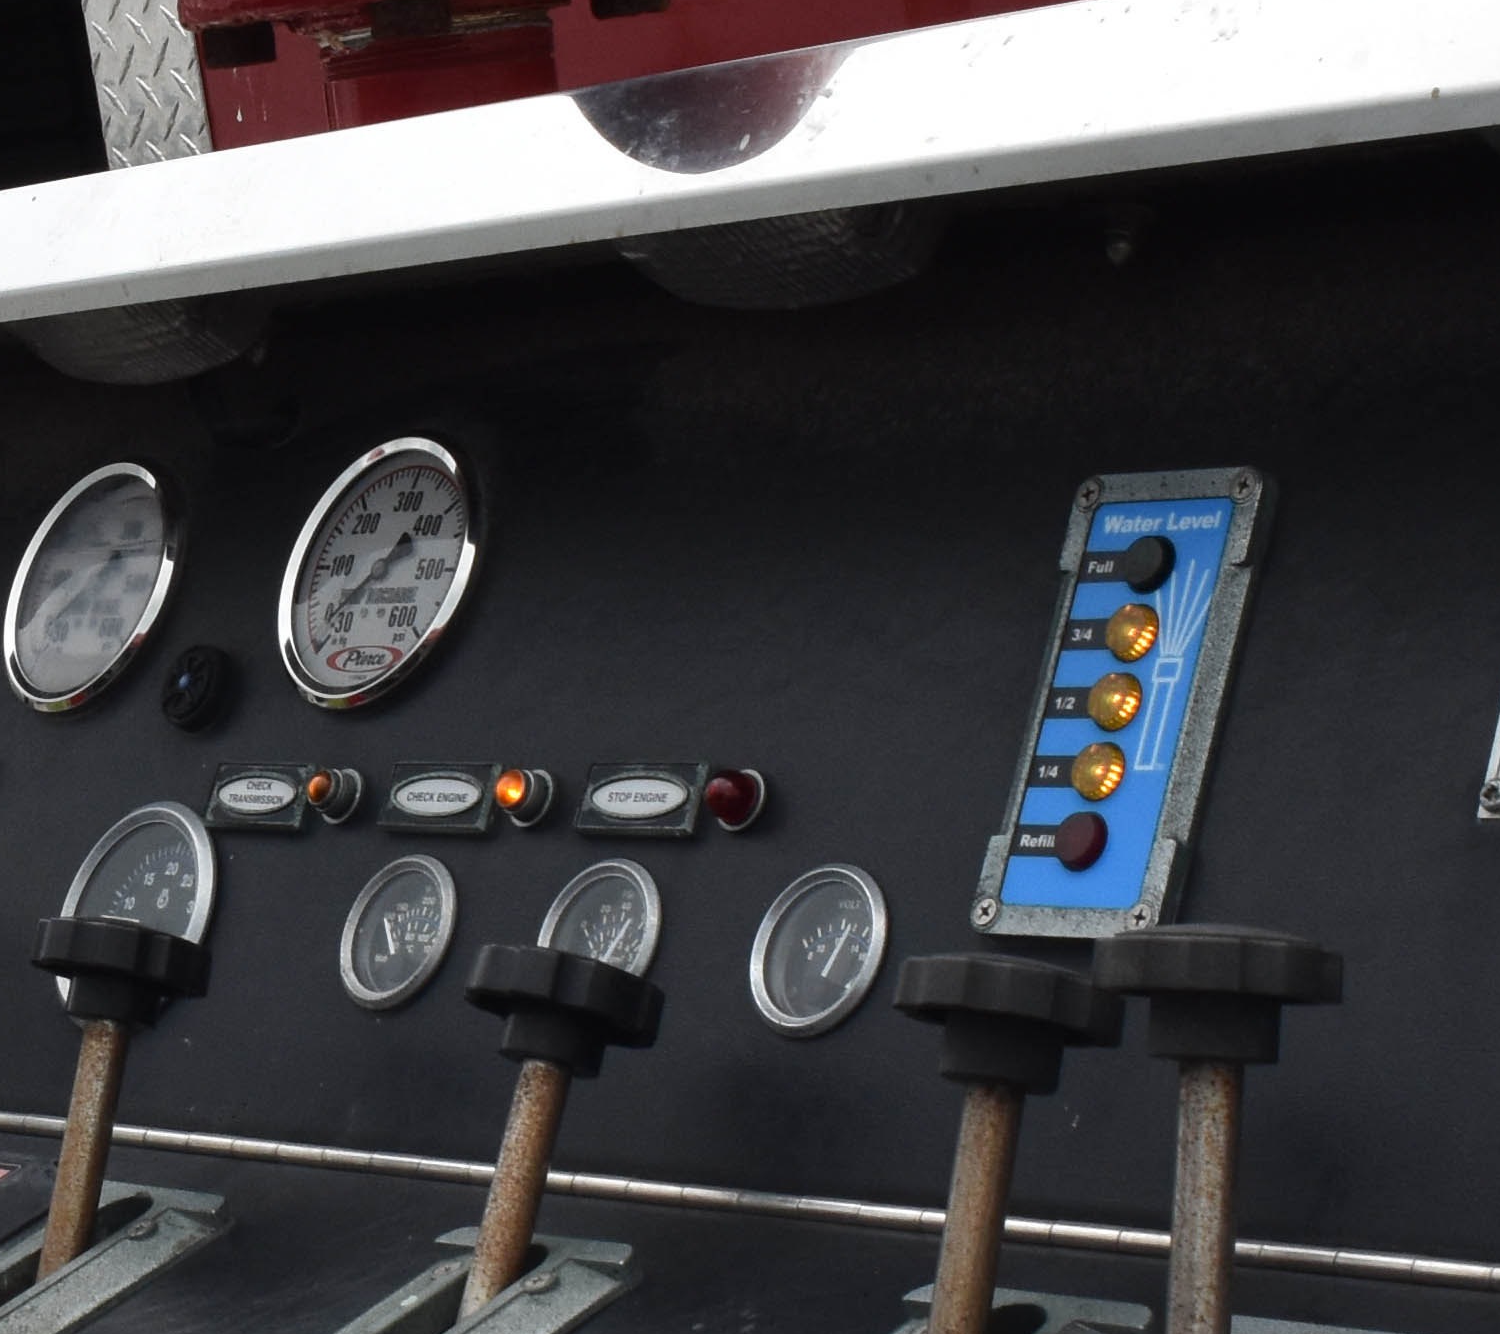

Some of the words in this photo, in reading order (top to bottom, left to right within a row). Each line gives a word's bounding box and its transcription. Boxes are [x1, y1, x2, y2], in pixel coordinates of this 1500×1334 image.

[393, 491, 424, 512] 300
[351, 513, 381, 535] 200
[413, 514, 443, 536] 400
[1103, 515, 1163, 535] Water
[1168, 511, 1222, 532] Level
[330, 554, 355, 577] 100
[415, 558, 446, 580] 500
[1087, 560, 1114, 575] Full
[388, 605, 418, 628] 600
[1071, 628, 1093, 643] 3/4
[341, 650, 387, 668] Pierce
[1055, 696, 1075, 711] 1/2
[1038, 764, 1058, 779] 1/4
[407, 792, 434, 802] CHECK
[436, 793, 468, 802] ENGINE
[608, 792, 632, 802] STOP
[633, 792, 668, 803] ENGINE
[1019, 834, 1055, 848] Refill
[164, 862, 179, 876] 20
[143, 872, 155, 886] 15
[123, 897, 135, 910] 10
